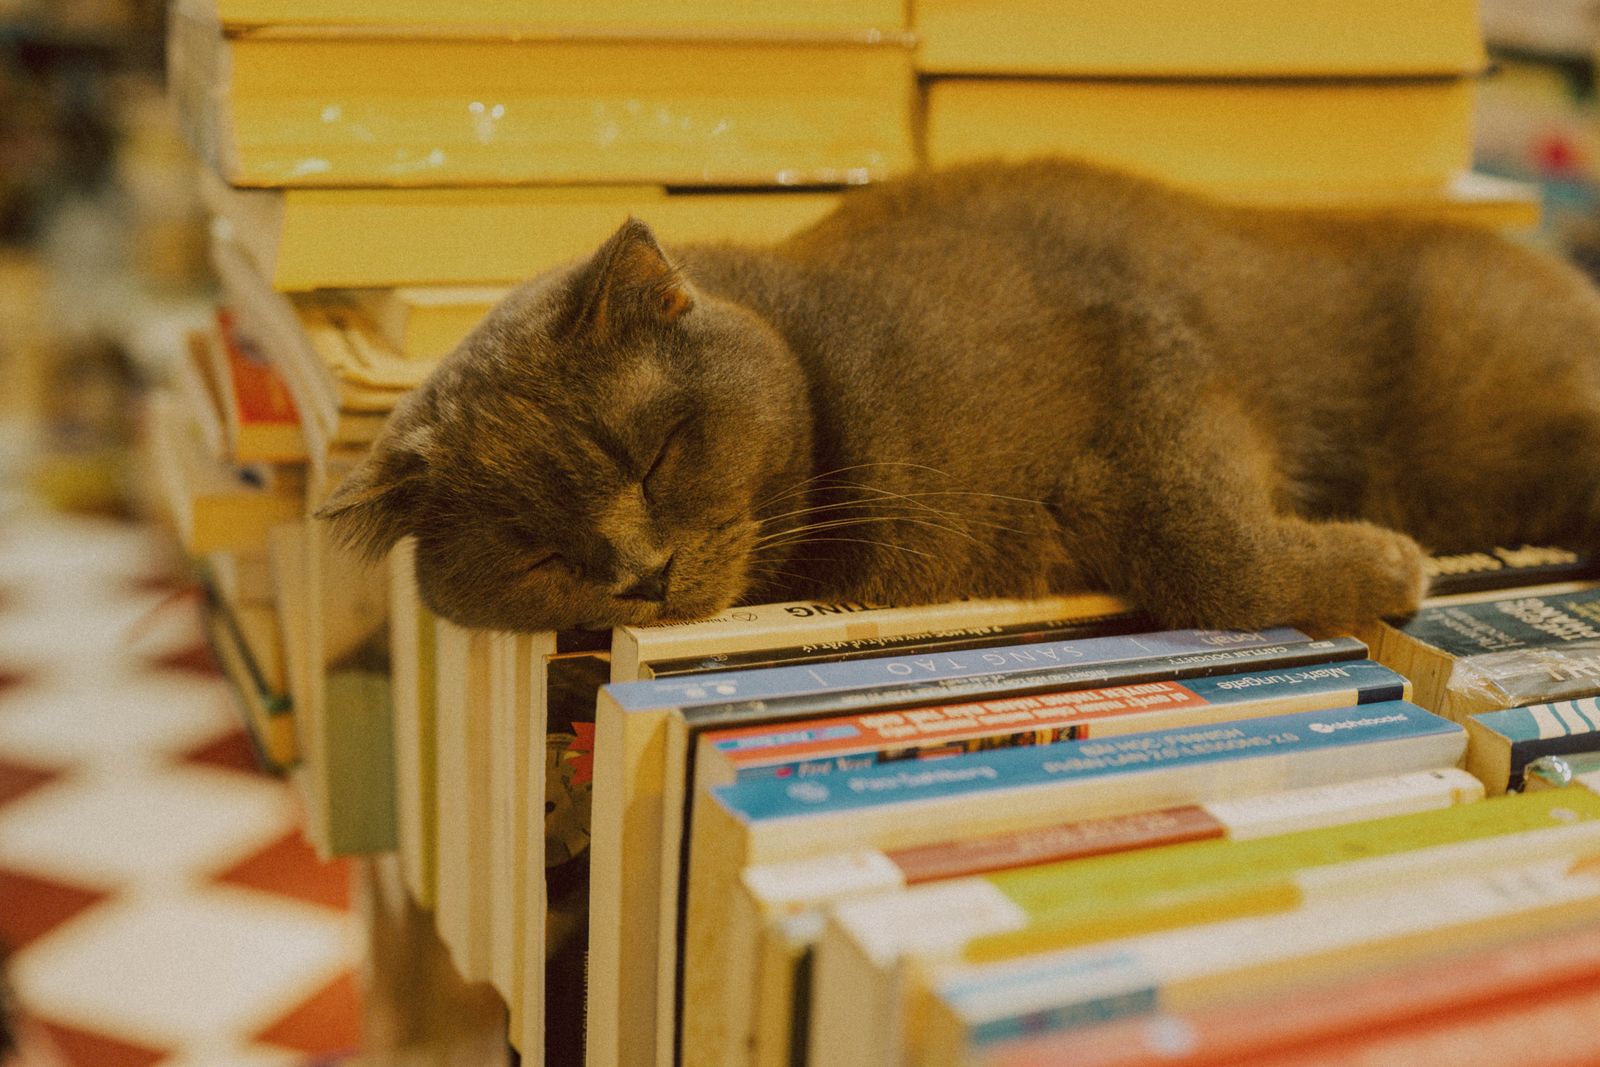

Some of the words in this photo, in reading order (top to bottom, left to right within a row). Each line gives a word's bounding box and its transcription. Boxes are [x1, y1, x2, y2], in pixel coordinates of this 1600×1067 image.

[982, 646, 1083, 666] SÁNG
[887, 658, 967, 676] TẠO
[1301, 667, 1351, 681] Mark
[1217, 673, 1303, 690] Tungate
